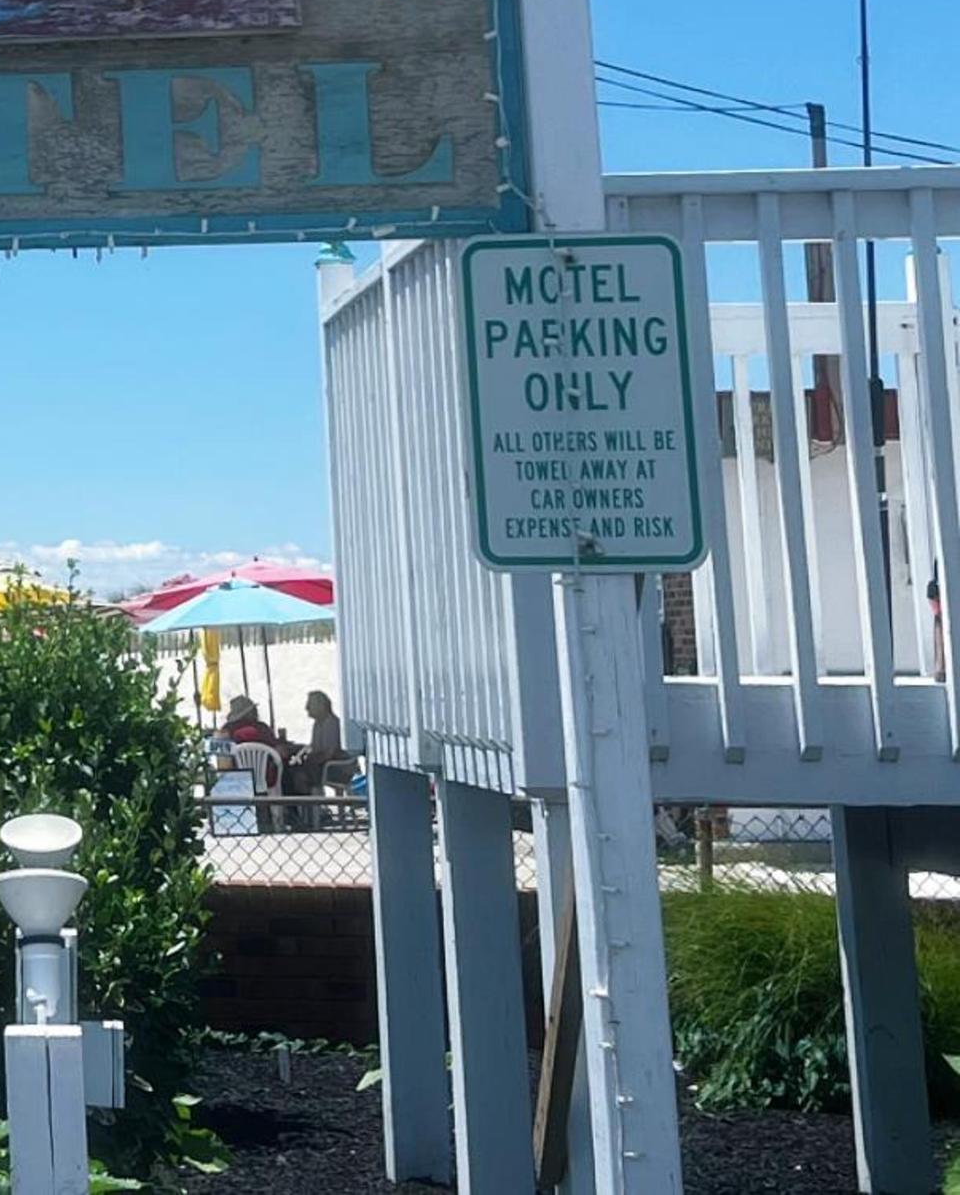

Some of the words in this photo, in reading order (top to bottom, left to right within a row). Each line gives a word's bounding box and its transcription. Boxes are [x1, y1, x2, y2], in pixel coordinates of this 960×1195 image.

[504, 263, 641, 305] MOTEL
[484, 316, 668, 359] PARKING
[524, 369, 633, 412] ONLY
[493, 432, 526, 453] ALL
[532, 430, 598, 453] OTHERS
[603, 430, 647, 452] WILL
[653, 429, 676, 451] BE
[580, 459, 628, 481] AWAY
[636, 459, 657, 480] AT
[530, 488, 566, 510] CAR
[572, 487, 645, 510] OWNERS
[592, 517, 626, 539] AND
[634, 516, 676, 538] RISK
